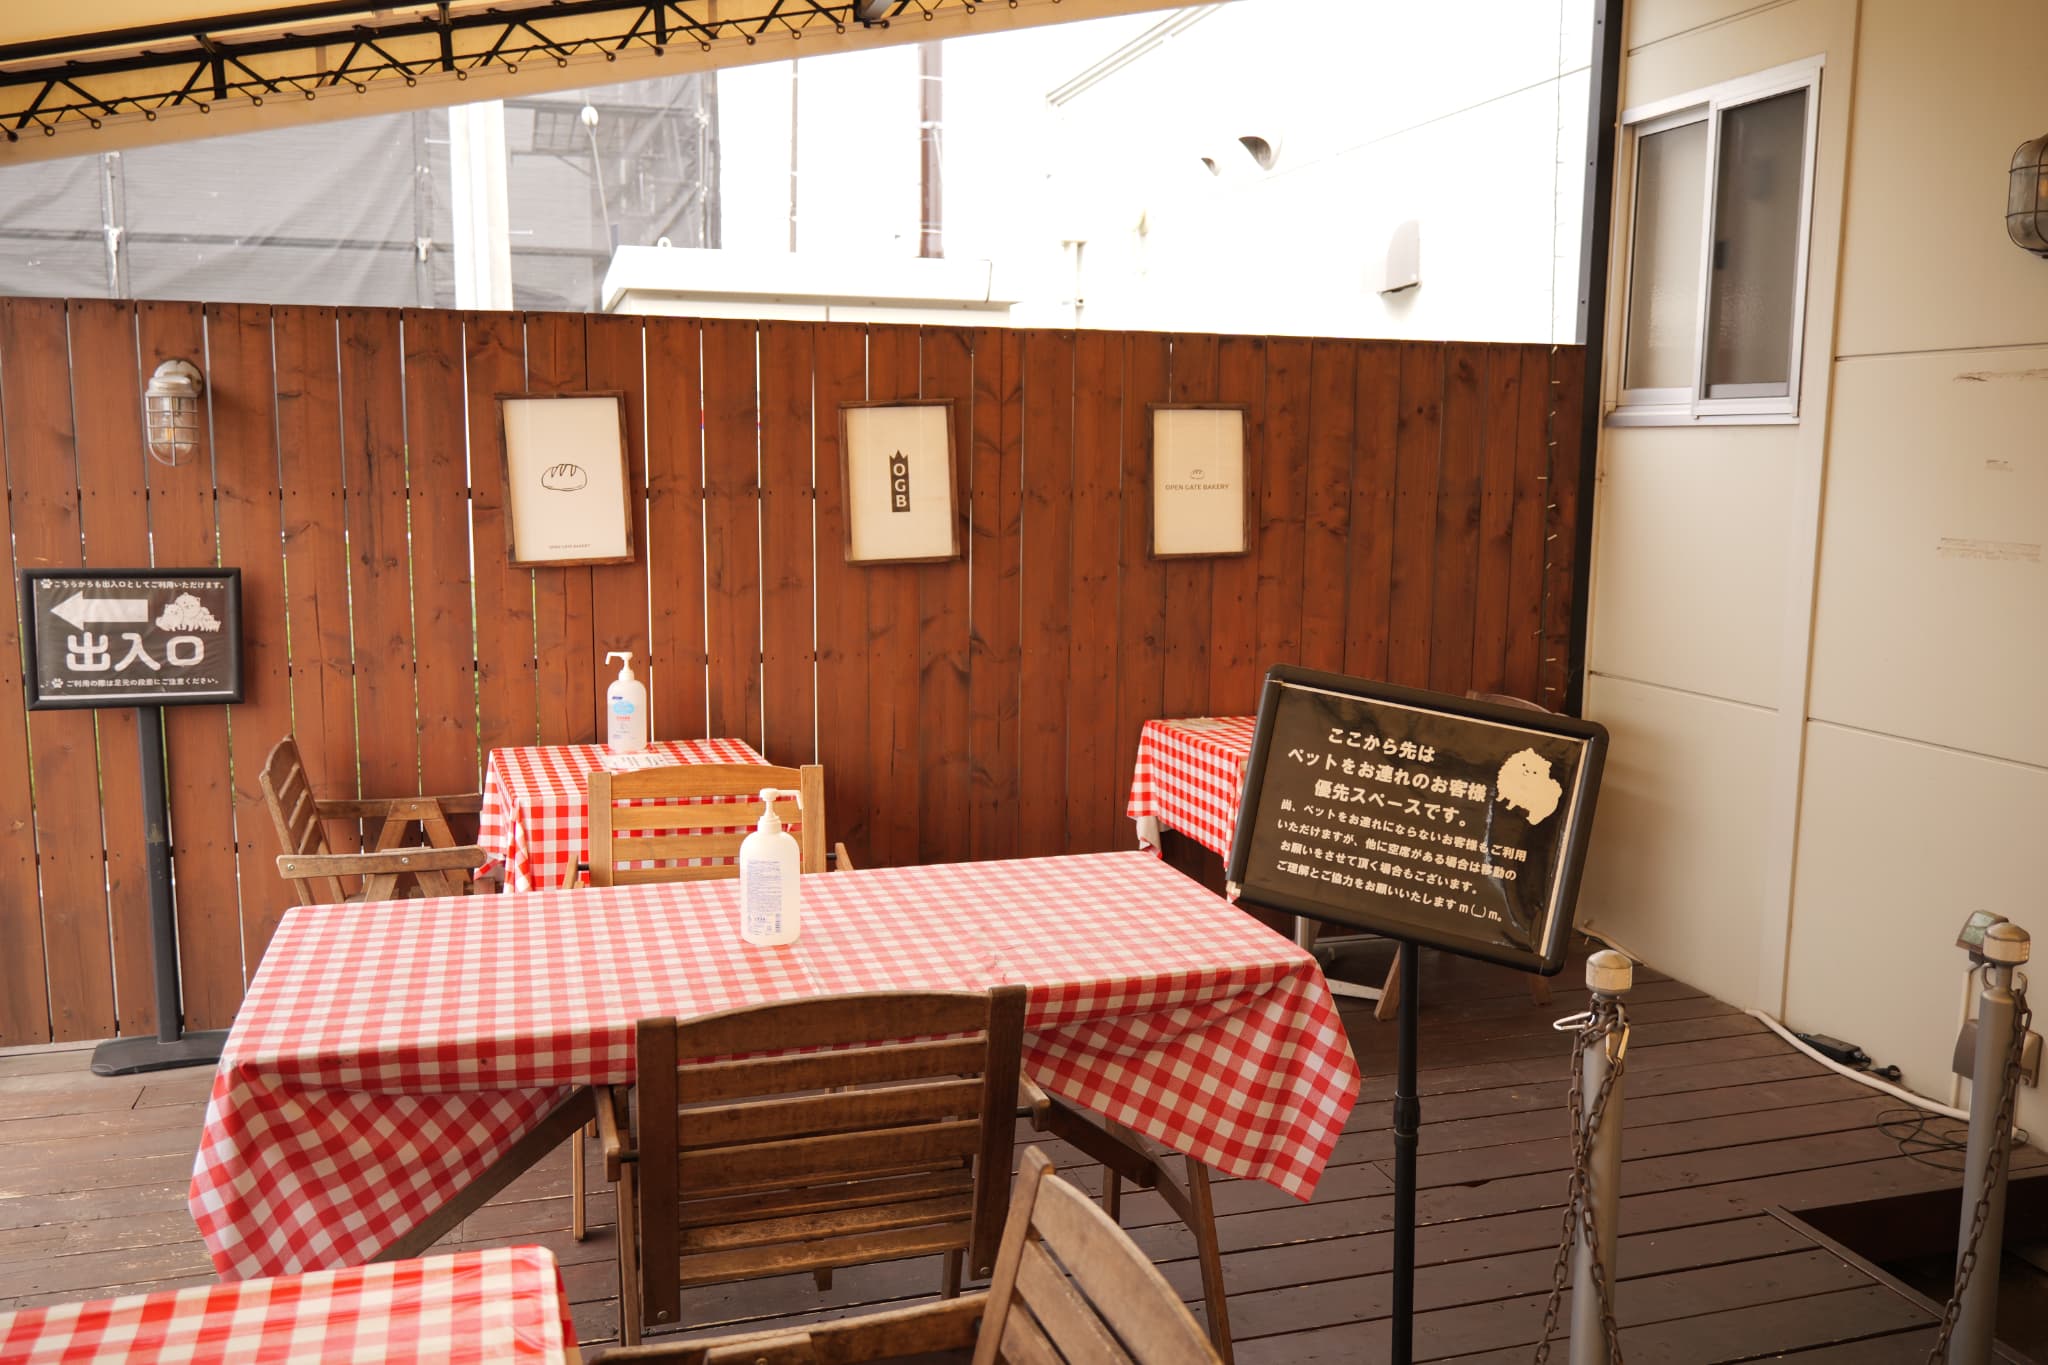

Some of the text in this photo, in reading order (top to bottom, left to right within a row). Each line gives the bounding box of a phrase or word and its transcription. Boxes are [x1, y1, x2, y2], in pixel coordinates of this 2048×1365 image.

[892, 463, 908, 508] OGB
[66, 631, 205, 673] 出入口
[1328, 727, 1436, 763] ここから先は
[1287, 748, 1488, 803] ペットをお連れのお客様
[1314, 778, 1467, 828] 優先スペースです。
